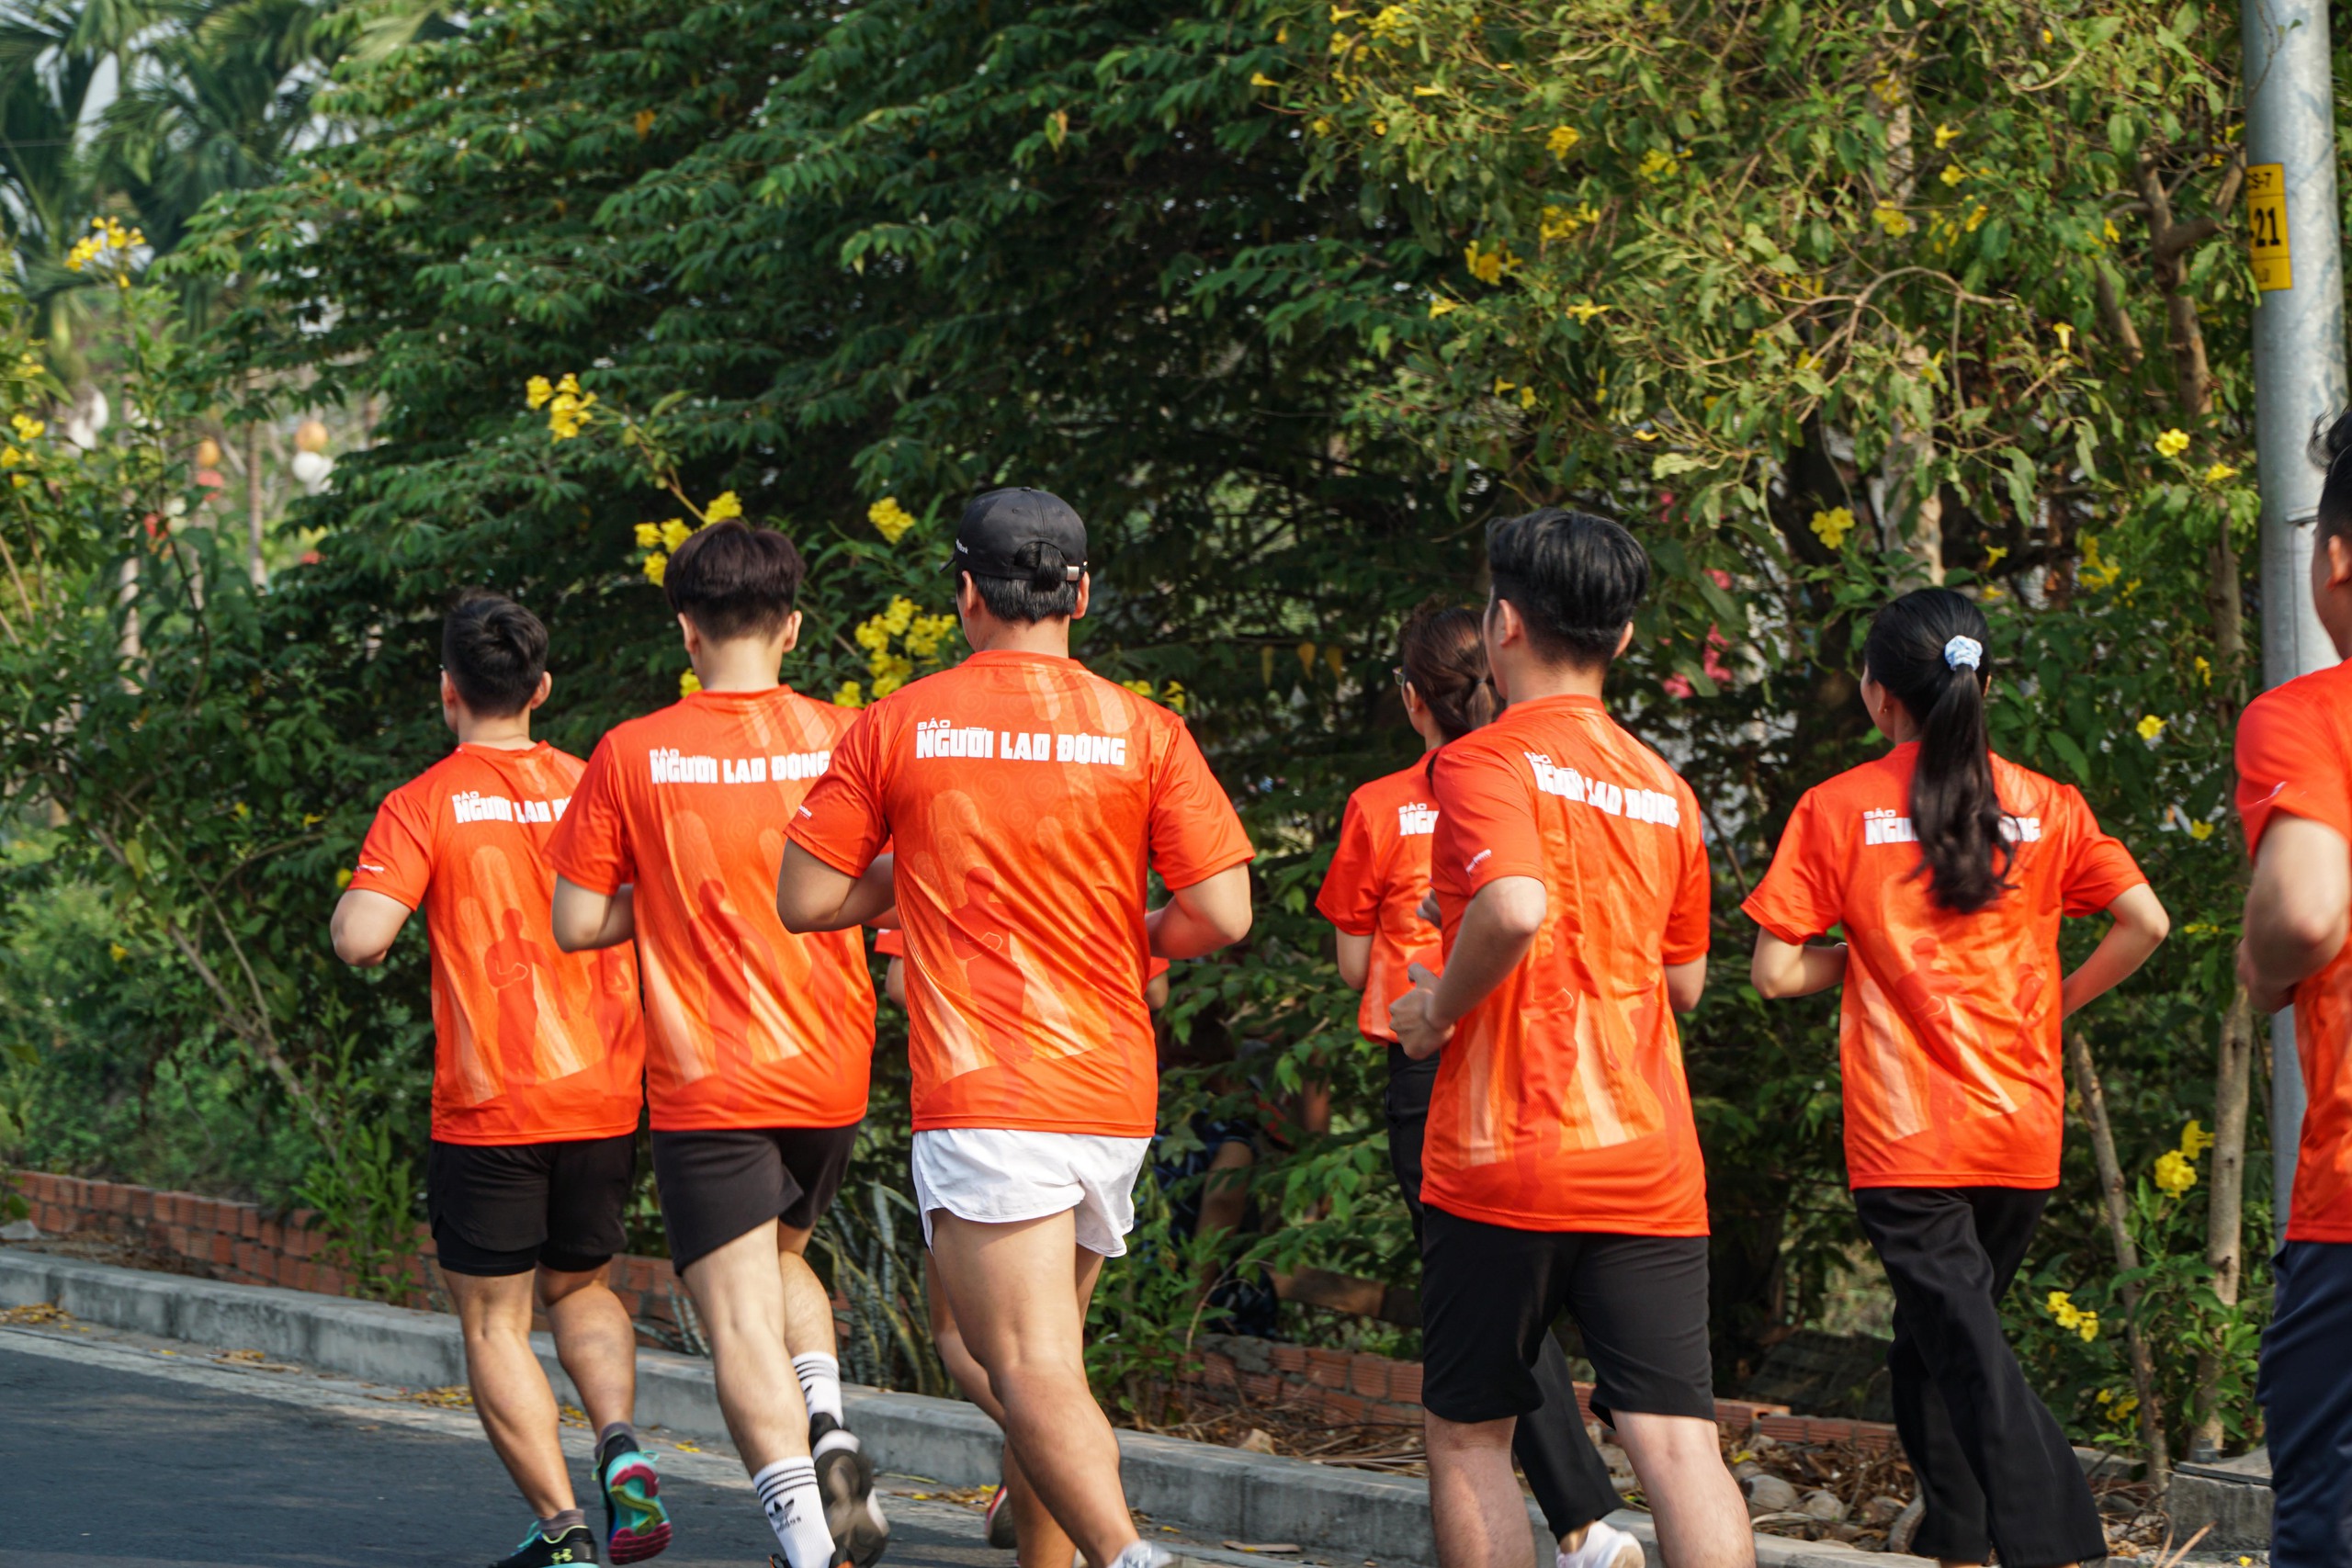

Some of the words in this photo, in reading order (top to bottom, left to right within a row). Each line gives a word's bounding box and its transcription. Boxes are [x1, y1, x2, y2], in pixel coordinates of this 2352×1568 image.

[917, 717, 951, 730] BÁO
[916, 727, 994, 759] NGƯỜI
[1001, 731, 1051, 761] LAO
[1056, 732, 1125, 766] ĐỘNG
[723, 757, 766, 784] LAO
[1585, 776, 1623, 817] LAO
[513, 800, 552, 824] LAO
[1863, 807, 1896, 819] BÁO
